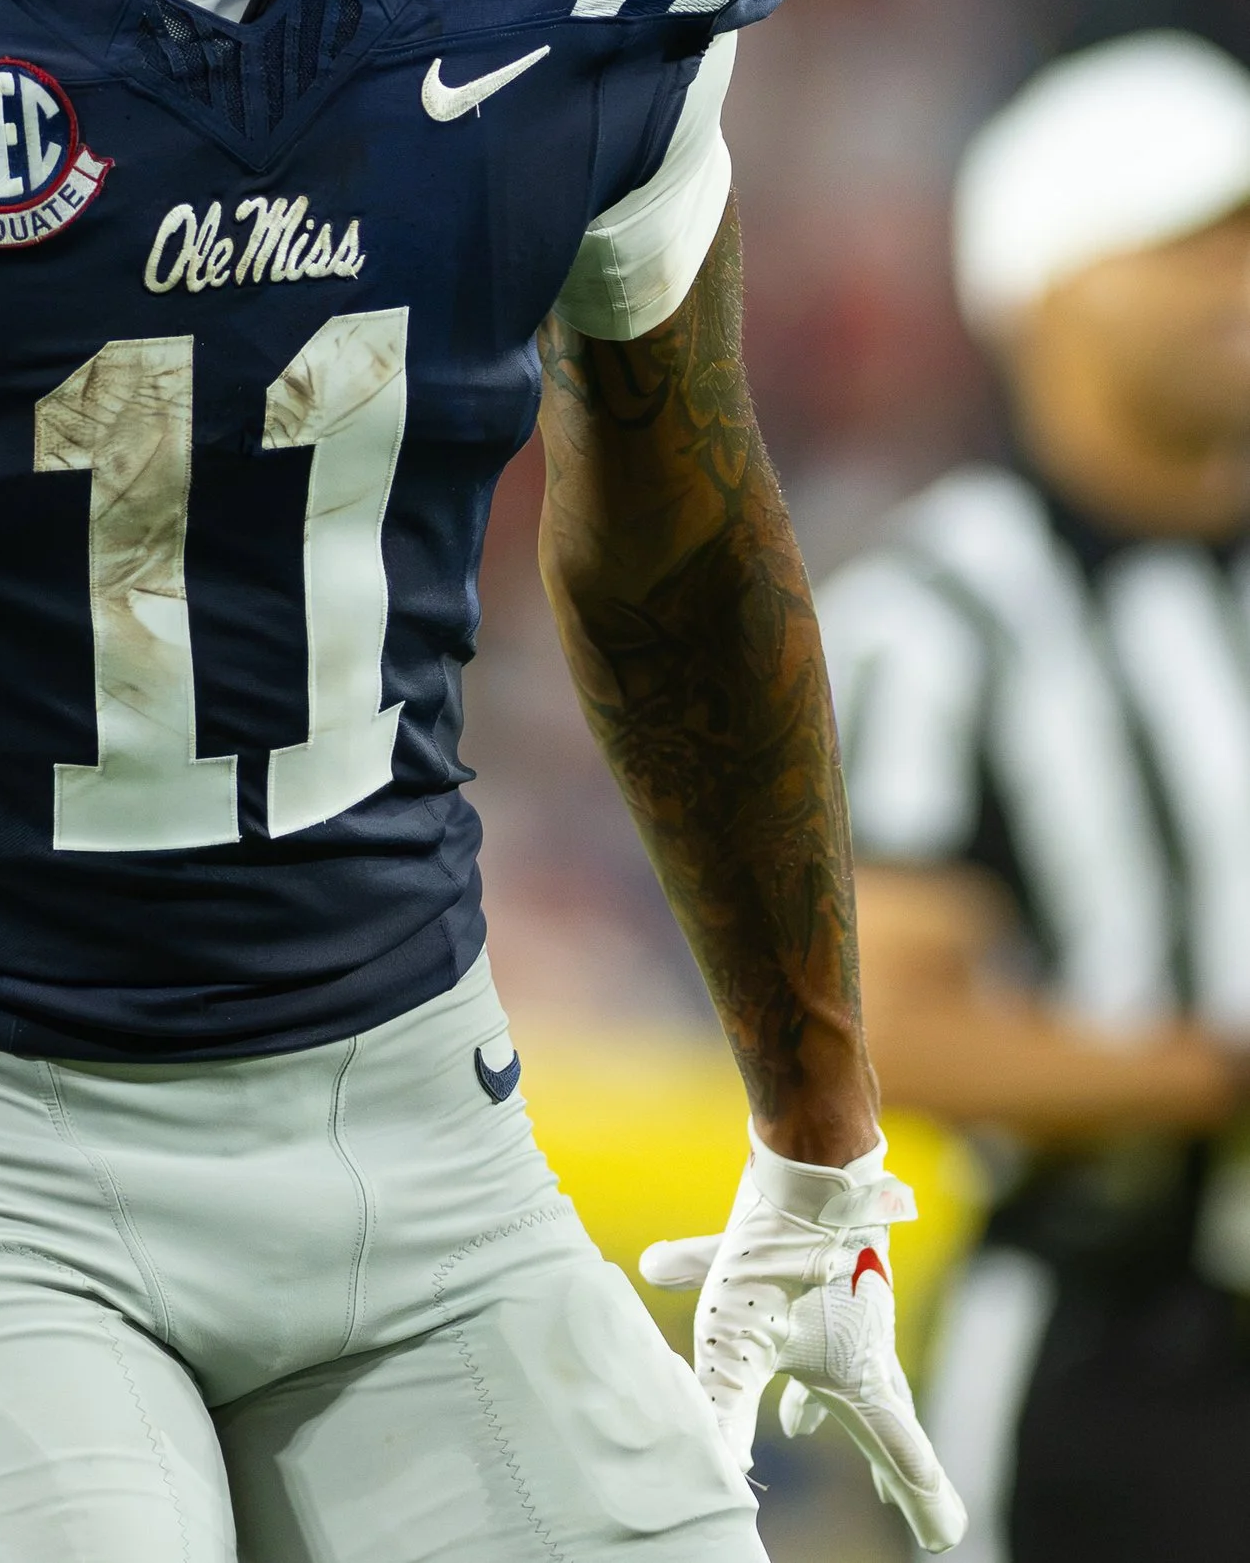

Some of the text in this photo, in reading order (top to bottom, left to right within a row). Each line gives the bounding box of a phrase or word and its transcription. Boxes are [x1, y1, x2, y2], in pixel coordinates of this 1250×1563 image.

[144, 194, 367, 294] Ole Miss
[33, 305, 410, 852] 11
